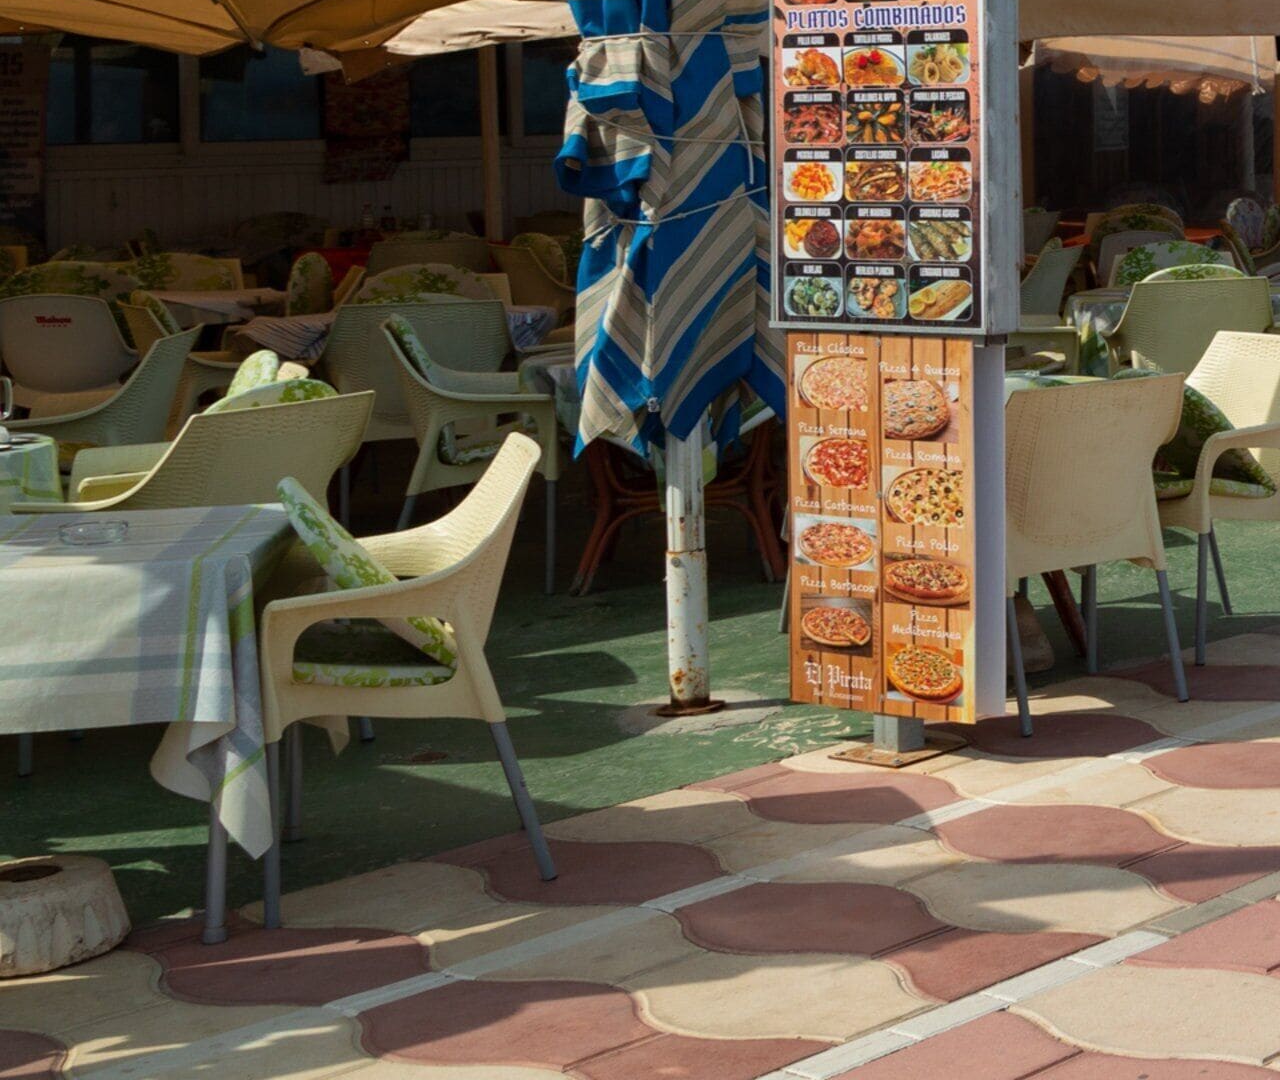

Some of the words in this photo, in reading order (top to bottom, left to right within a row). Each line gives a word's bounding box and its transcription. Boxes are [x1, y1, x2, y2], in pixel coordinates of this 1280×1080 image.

[787, 9, 848, 29] PLATOS
[854, 4, 966, 28] COMBINADOS
[796, 342, 823, 353] Pizza
[828, 343, 865, 355] Clásica
[879, 362, 906, 373] Pizza
[924, 364, 960, 376] Quesos
[798, 423, 824, 434] Pizza
[828, 424, 867, 436] Serrana
[885, 448, 912, 460] Pizza
[917, 452, 961, 463] Romana
[795, 498, 821, 509] Pizza
[824, 499, 876, 513] Carbonara
[895, 537, 925, 549] Pizza
[930, 539, 959, 552] Pollo
[800, 576, 826, 588] Pizza
[830, 579, 877, 593] Barbacoa
[910, 610, 938, 622] Pizza
[804, 661, 822, 684] El
[827, 664, 873, 691] Pirata
